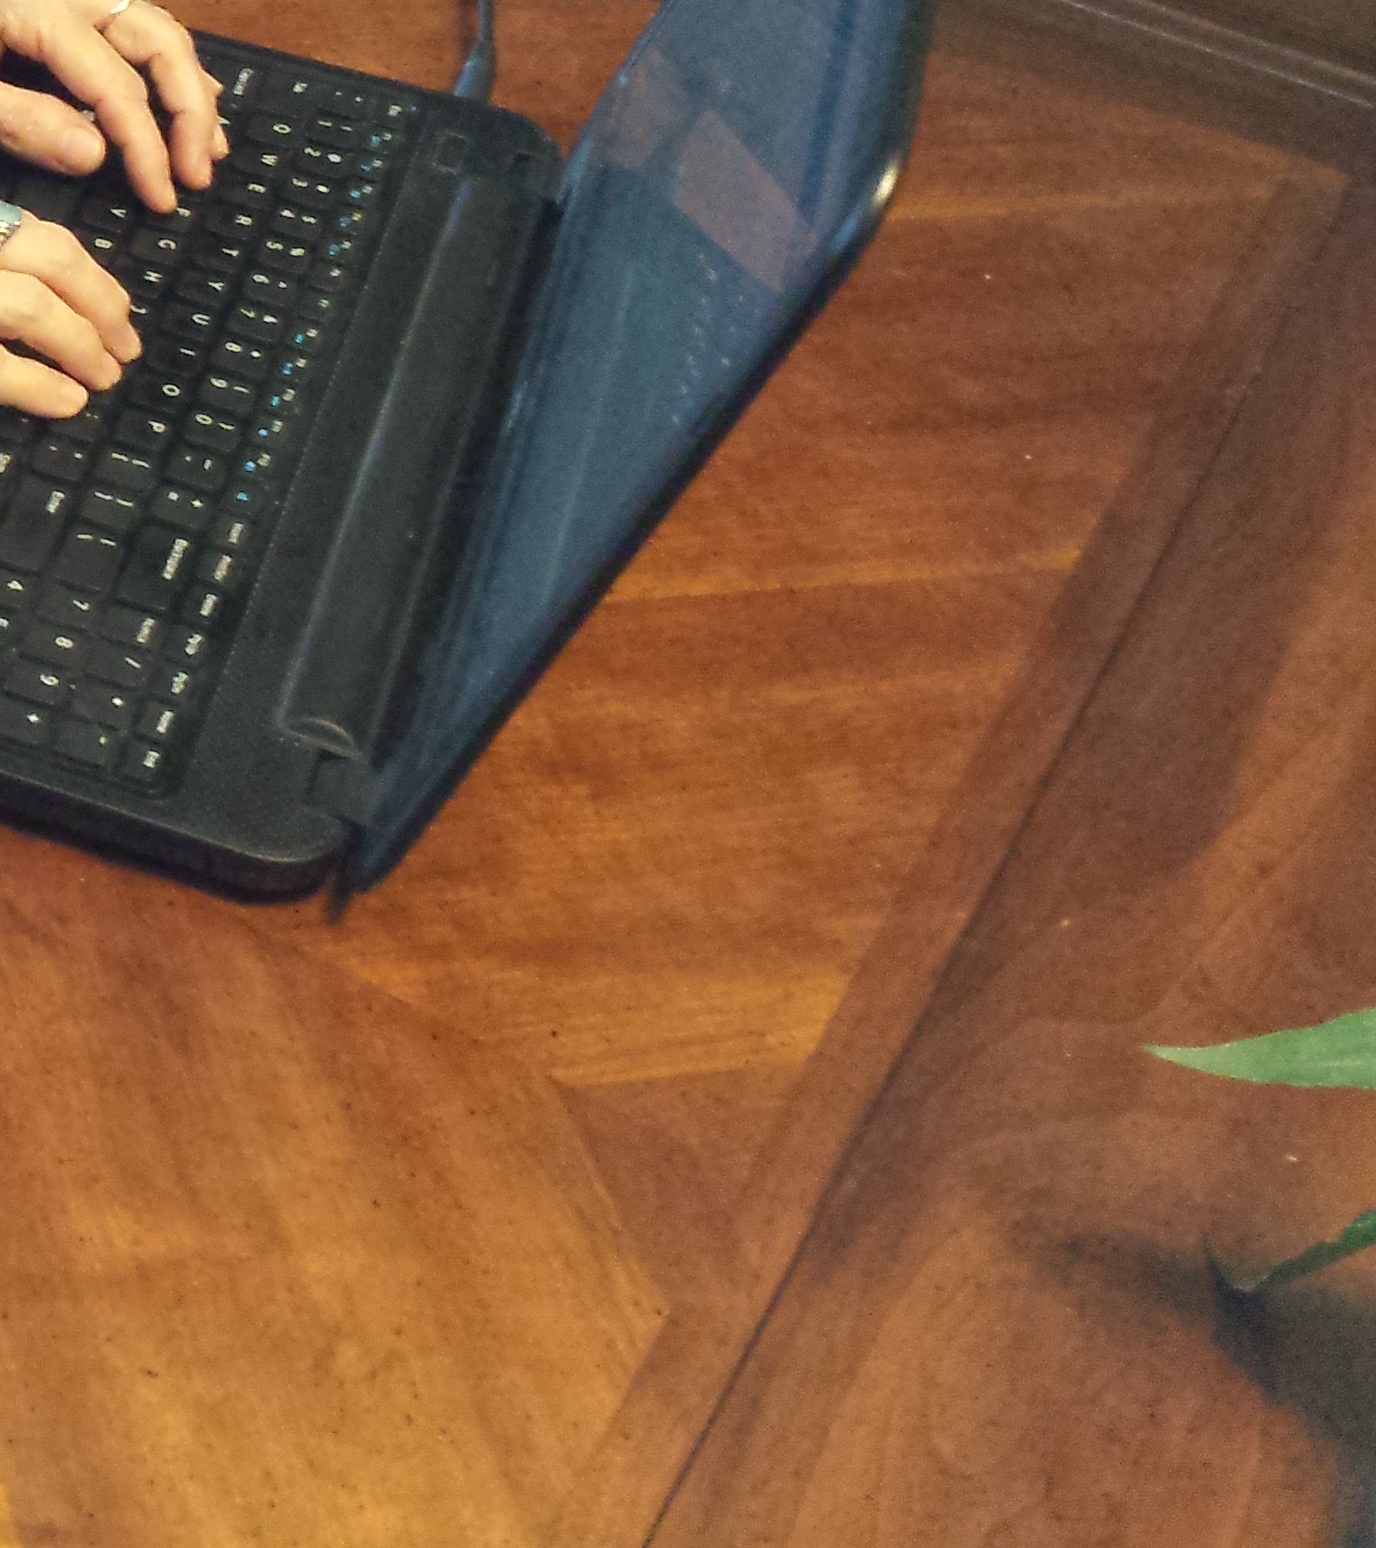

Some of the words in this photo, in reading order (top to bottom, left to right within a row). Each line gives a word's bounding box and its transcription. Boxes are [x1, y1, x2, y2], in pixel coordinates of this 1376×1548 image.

[272, 123, 292, 134] Q
[304, 147, 322, 157] 2
[260, 154, 278, 166] W
[247, 183, 266, 194] E
[292, 178, 308, 188] 3
[110, 208, 127, 218] V
[280, 209, 295, 219] 4
[235, 215, 254, 226] R
[94, 238, 113, 249] B
[157, 239, 177, 250] G
[265, 241, 284, 251] 5
[221, 248, 240, 257] T
[143, 271, 163, 283] H
[252, 274, 270, 284] 6
[207, 281, 225, 291] Y
[240, 308, 256, 318] 7
[191, 313, 211, 326] U
[224, 342, 243, 353] 8
[210, 378, 228, 388] 9
[162, 384, 181, 397] O
[195, 413, 213, 425] 0
[148, 420, 166, 433] P
[6, 580, 24, 591] 4
[72, 599, 90, 611] 7
[55, 636, 74, 649] 8
[39, 674, 59, 686] 9
